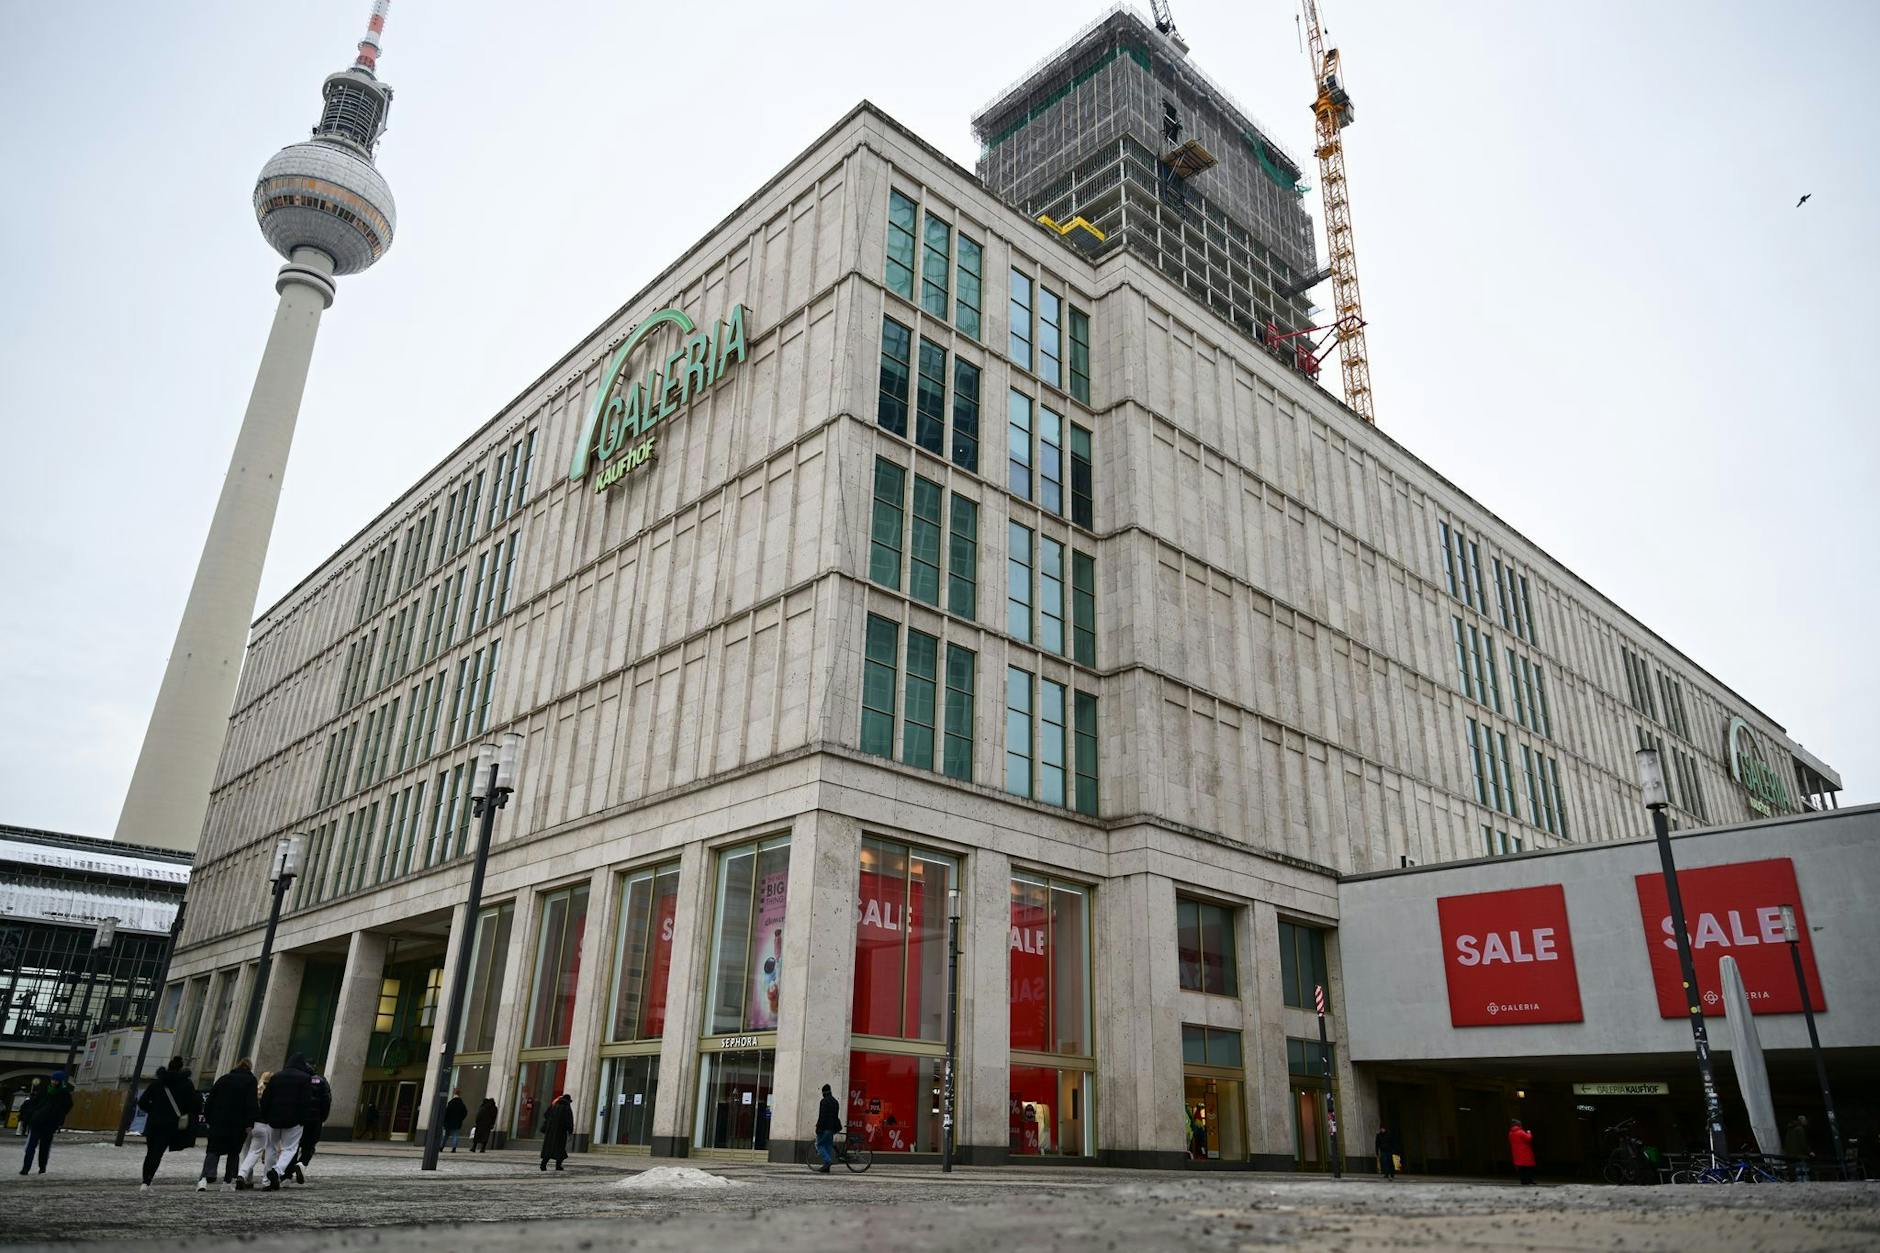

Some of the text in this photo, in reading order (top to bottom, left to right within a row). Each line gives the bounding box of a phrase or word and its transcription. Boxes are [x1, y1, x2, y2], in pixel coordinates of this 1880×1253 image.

[597, 303, 747, 461] GALERIA
[766, 881, 785, 897] BIG
[1456, 927, 1559, 967] SALE
[1501, 1003, 1540, 1012] GALERIA
[721, 1036, 758, 1048] SEPHORA
